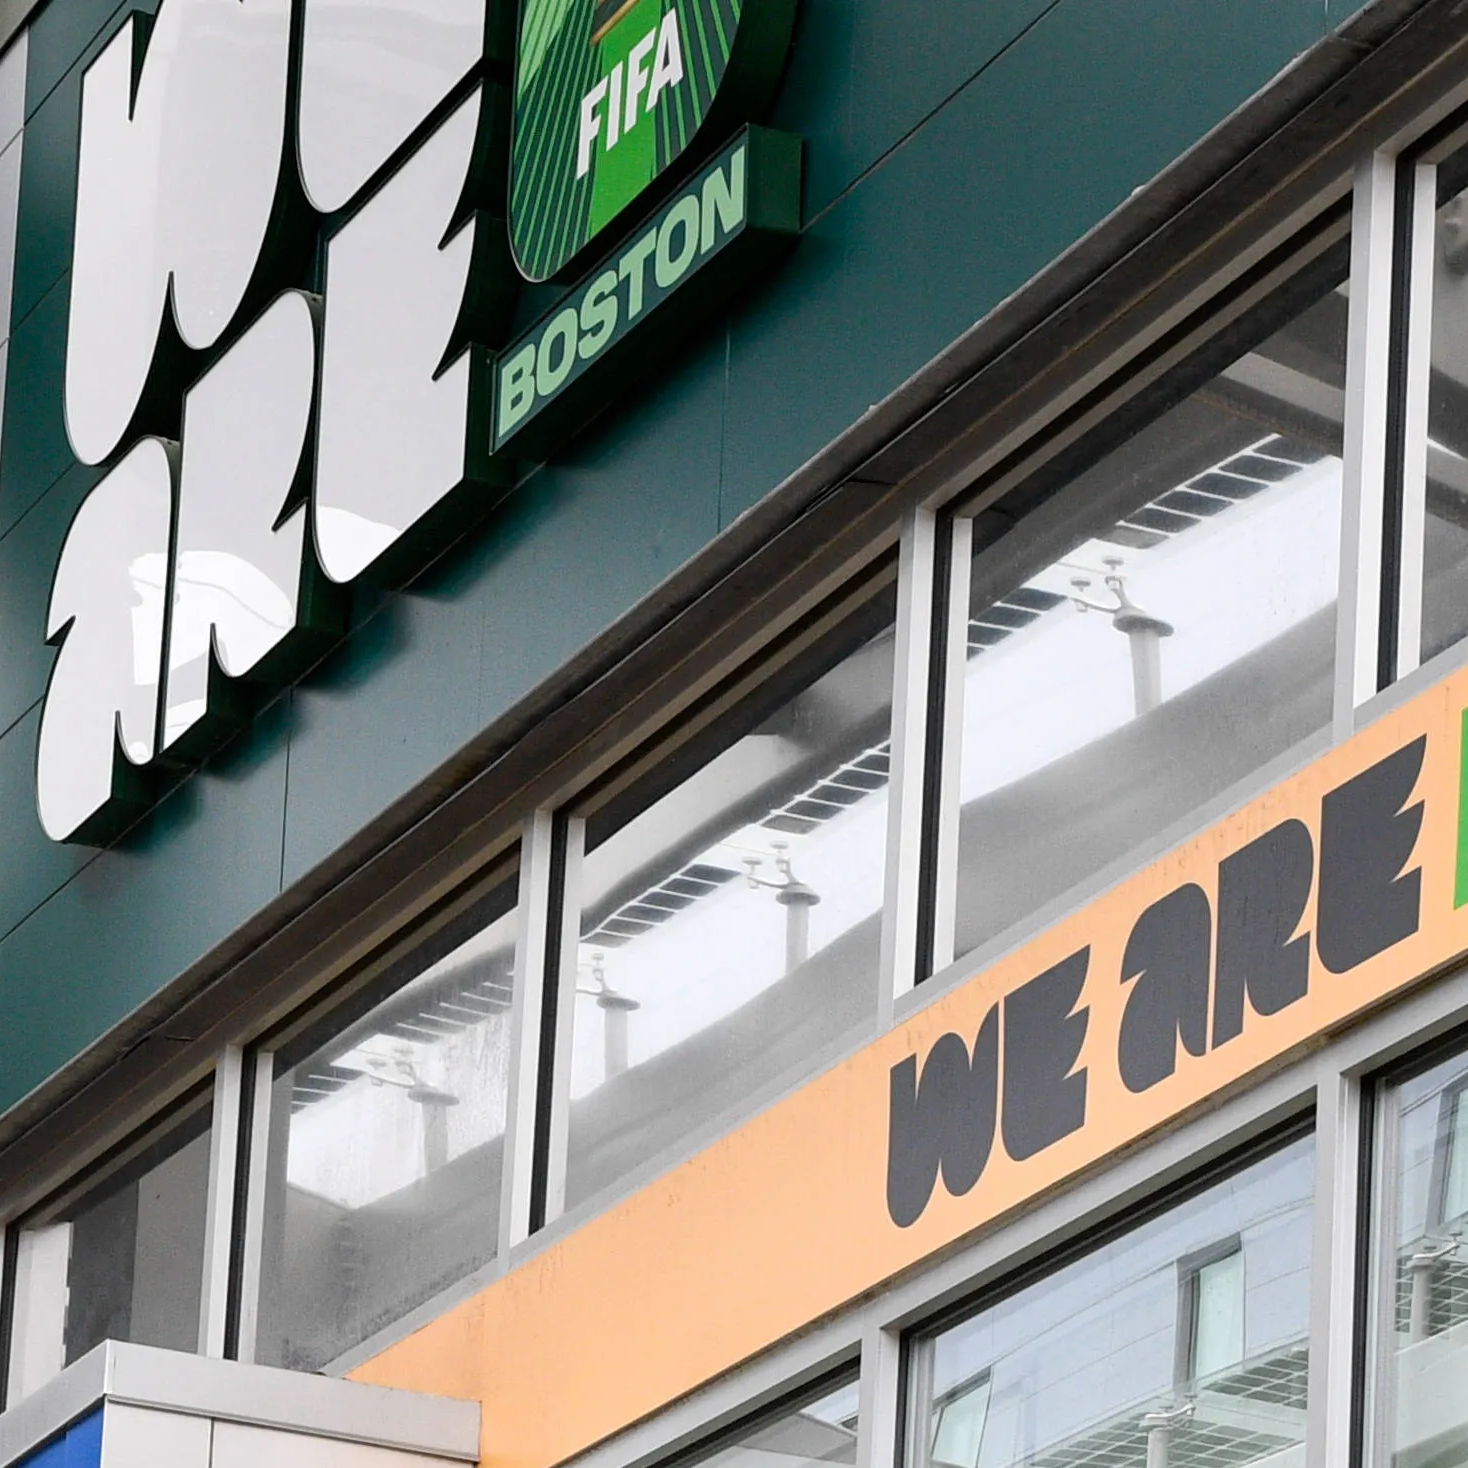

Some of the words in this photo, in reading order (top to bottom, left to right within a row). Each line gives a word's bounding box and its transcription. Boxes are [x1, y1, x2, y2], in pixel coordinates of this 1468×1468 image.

[576, 8, 684, 179] FIFA
[498, 147, 746, 441] BOSTON
[887, 944, 1091, 1228] WE
[1117, 733, 1428, 1093] ARE
